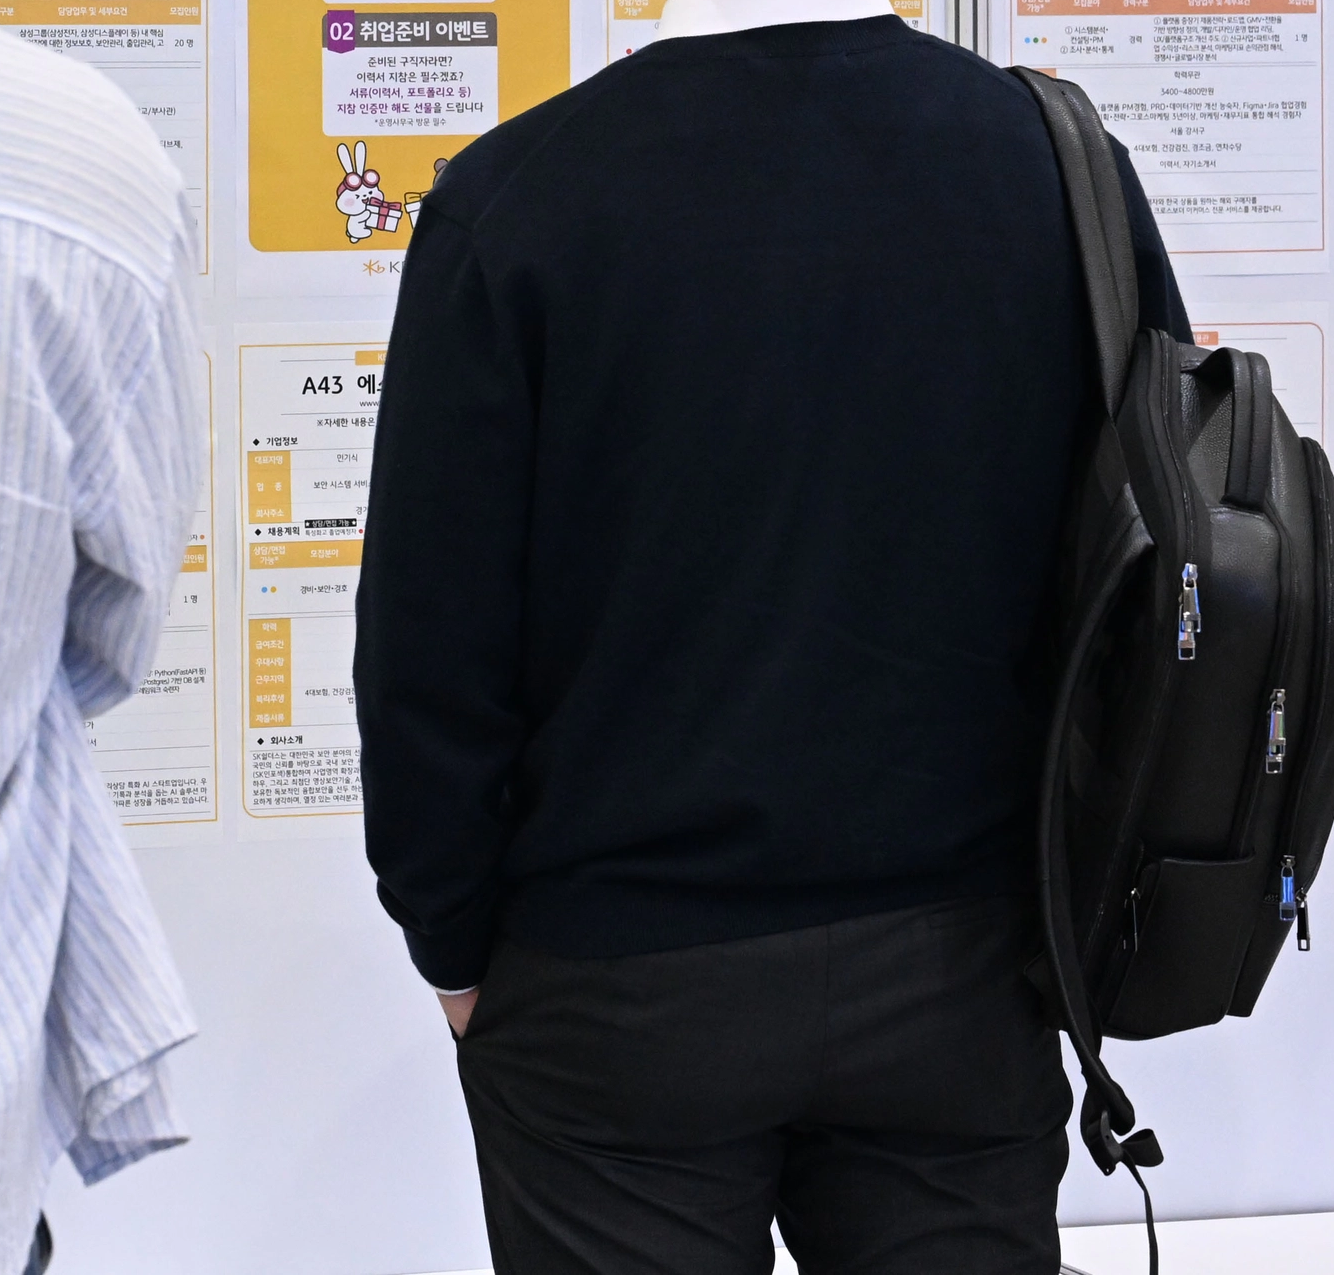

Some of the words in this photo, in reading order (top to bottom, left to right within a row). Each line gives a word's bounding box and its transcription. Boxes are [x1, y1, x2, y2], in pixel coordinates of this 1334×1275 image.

[330, 23, 353, 40] 02
[360, 21, 429, 42] 취업준비
[436, 21, 488, 41] 이벤트
[367, 56, 397, 68] 준비된
[399, 55, 453, 68] 구직자라면?
[356, 71, 385, 84] 이력서
[388, 71, 418, 83] 지참은
[420, 71, 464, 83] 필수겠죠?
[349, 87, 404, 99] 서류(이력서,
[406, 86, 455, 99] 포트폴리오
[458, 86, 471, 99] 등)
[337, 103, 357, 115] 지참
[359, 102, 389, 115] 인증만
[391, 102, 411, 114] 해도
[413, 101, 443, 114] 선물을
[445, 101, 484, 114] 드립니다
[415, 117, 431, 127] 방문
[432, 117, 447, 127] 필수
[302, 376, 343, 394] A43
